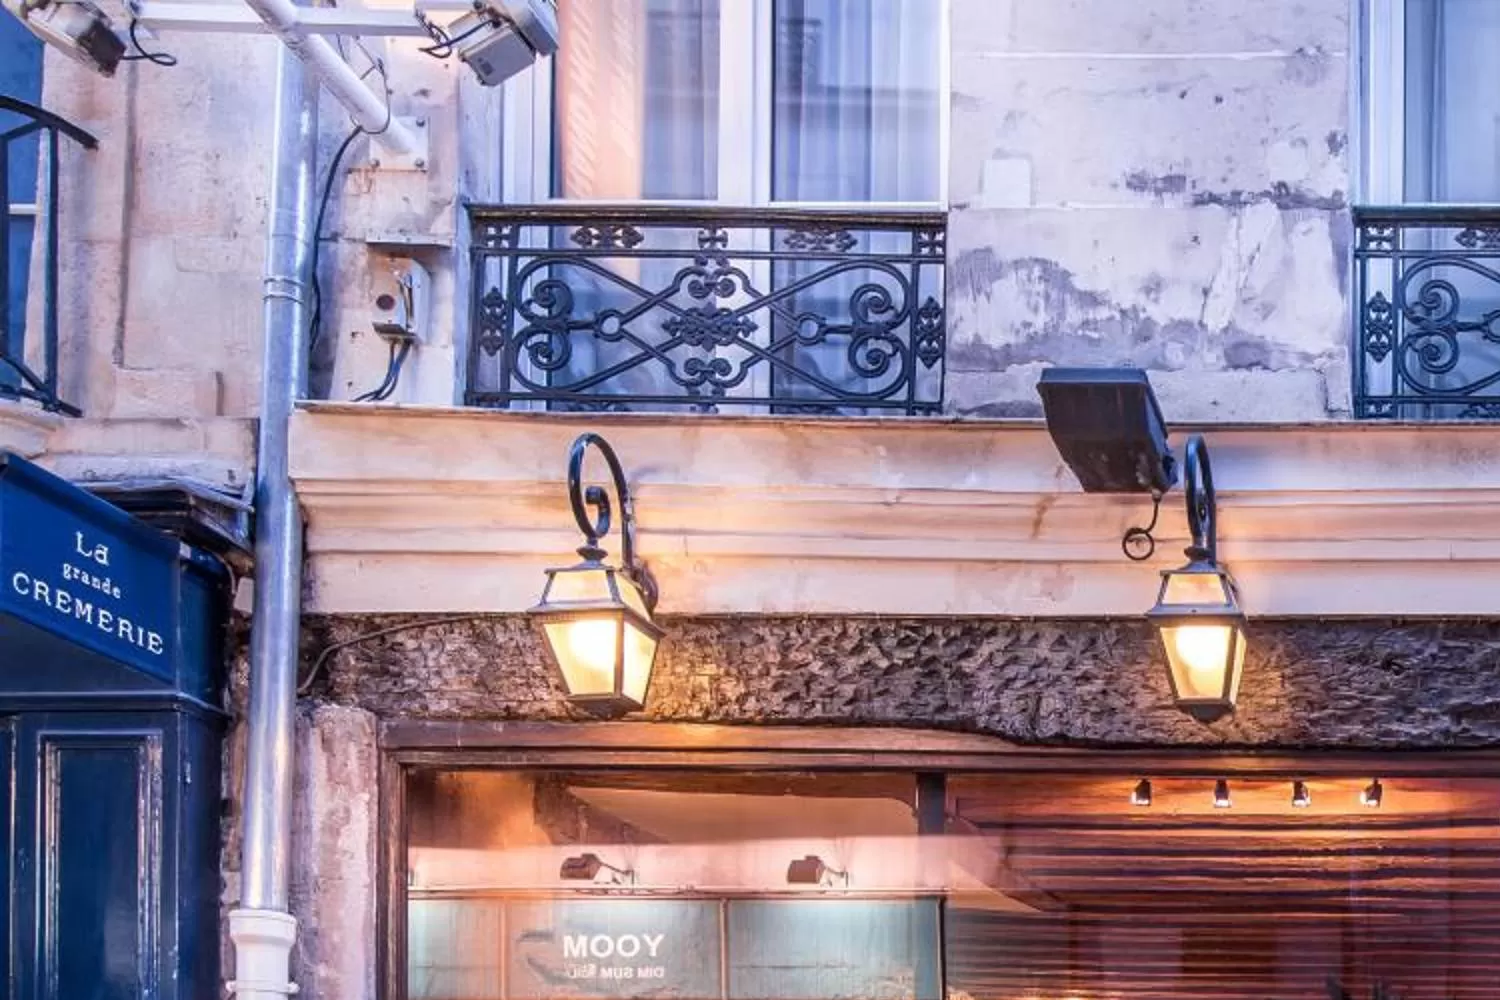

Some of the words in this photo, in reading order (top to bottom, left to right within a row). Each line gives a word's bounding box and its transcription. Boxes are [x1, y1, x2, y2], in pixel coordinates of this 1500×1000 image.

[75, 530, 110, 566] La
[62, 562, 121, 599] grande
[12, 572, 164, 656] CREMERIE
